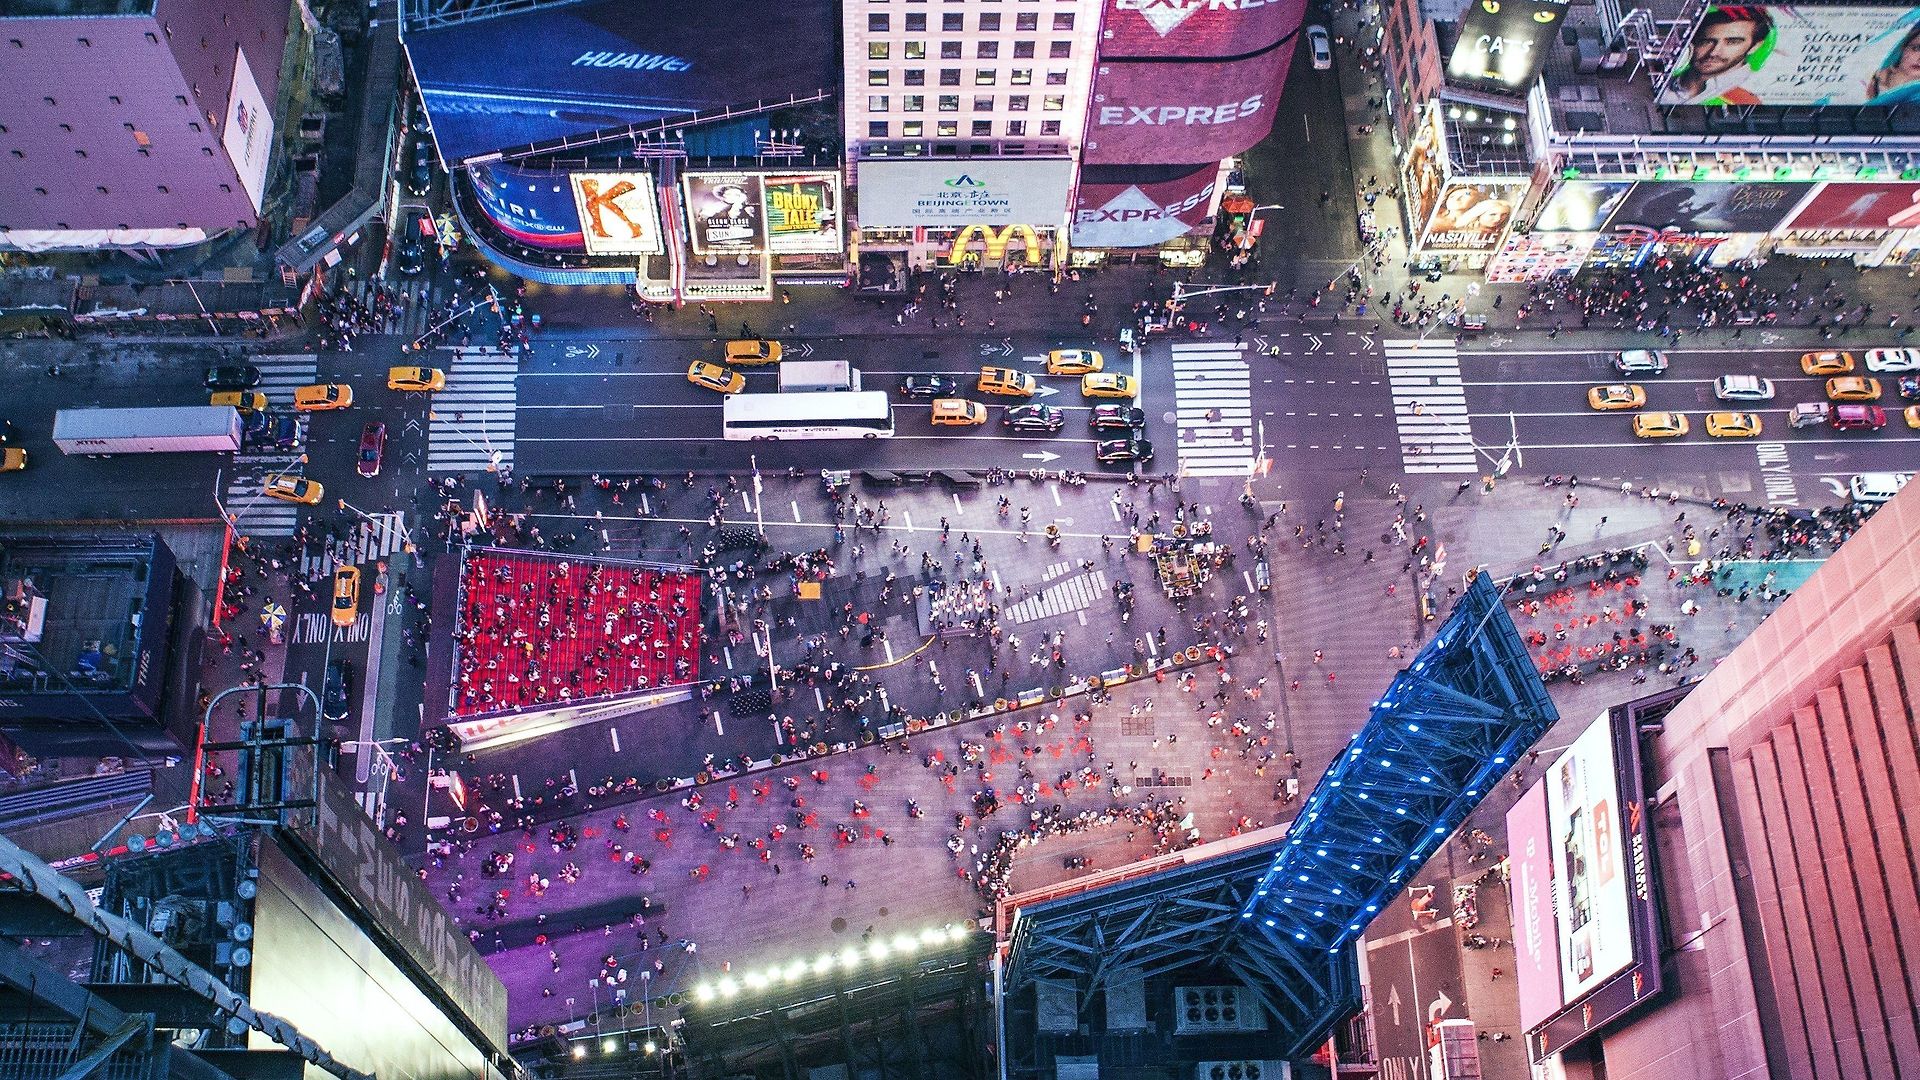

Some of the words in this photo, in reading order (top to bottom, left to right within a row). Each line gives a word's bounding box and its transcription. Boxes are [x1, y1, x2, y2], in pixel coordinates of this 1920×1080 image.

[1475, 34, 1534, 55] CATS
[1801, 44, 1822, 53] IN
[571, 51, 693, 71] HUAWEI
[1797, 65, 1842, 73] WITH
[1100, 94, 1265, 126] EXPRES
[773, 192, 818, 210] BRONX
[1076, 182, 1215, 225] EXPRESS
[784, 208, 816, 226] TALE
[1426, 232, 1498, 244] NASHVILLE
[1756, 444, 1790, 472] ONLY
[1764, 477, 1799, 506] ONLY
[292, 613, 327, 643] ONLY
[138, 650, 151, 686] THIS
